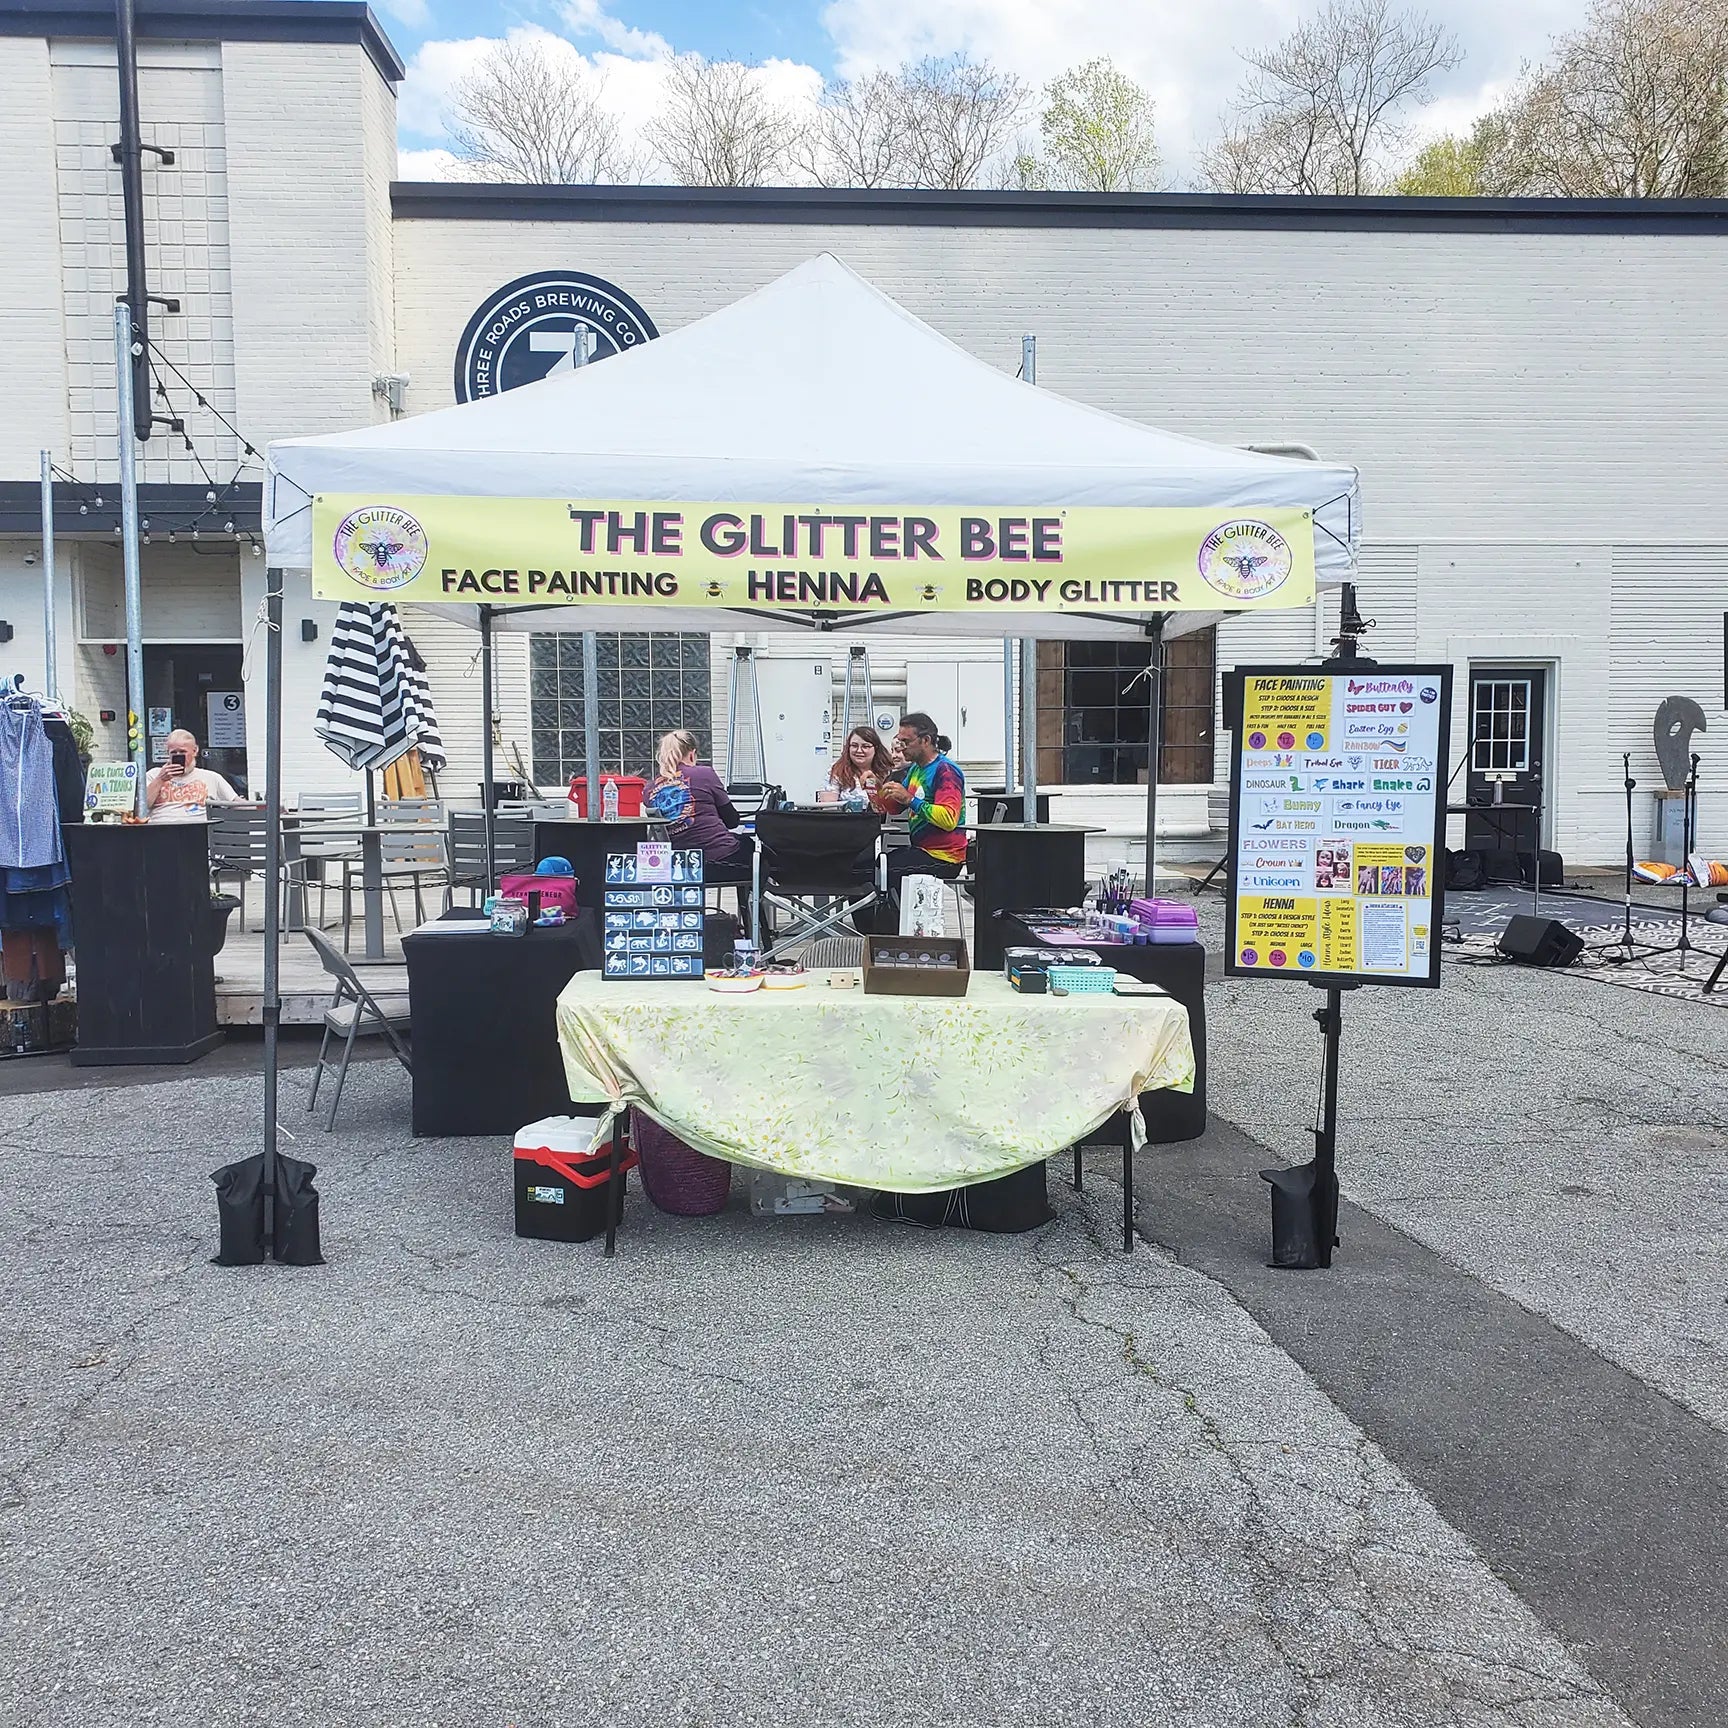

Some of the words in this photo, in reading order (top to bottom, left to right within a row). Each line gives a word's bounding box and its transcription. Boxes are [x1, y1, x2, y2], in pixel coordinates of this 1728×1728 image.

[477, 349, 492, 400] HREE
[485, 301, 531, 345] ROADS
[535, 293, 616, 323] BREWING
[340, 520, 359, 537] THE
[358, 511, 403, 525] GLITTER
[401, 520, 420, 537] BEE
[570, 510, 684, 556] THE
[700, 513, 945, 560] GLITTER
[960, 517, 1063, 562] BEE
[1205, 534, 1224, 551] THE
[1223, 525, 1267, 539] GLITTER
[1266, 534, 1284, 551] BEE
[353, 566, 371, 582] FACE
[380, 576, 400, 584] BODY
[401, 565, 412, 579] ART
[441, 569, 519, 593] FACE
[528, 570, 679, 596] PAINTING
[748, 570, 891, 604] HENNA
[1216, 579, 1235, 592] FACE
[1244, 585, 1264, 594] BODY
[1266, 573, 1276, 589] ART
[966, 578, 1052, 602] BODY
[1059, 580, 1182, 603] GLITTER
[1254, 679, 1278, 691] FACE
[1280, 679, 1325, 691] PAINTING
[1365, 680, 1413, 693] Butterfly
[227, 697, 237, 709] 3
[1346, 704, 1376, 713] SPIDER
[1378, 704, 1396, 712] GUY
[1348, 724, 1375, 734] Easter
[1378, 724, 1394, 735] Egg
[1345, 742, 1381, 750] RAINBOW
[1304, 759, 1328, 768] Tribal
[1329, 759, 1342, 767] Eye
[1373, 759, 1400, 769] TIGER
[1246, 780, 1286, 788] DINOSAUR
[1332, 780, 1365, 790] Shark
[1373, 779, 1413, 790] Snake
[1283, 799, 1321, 812] Bunny
[1356, 800, 1382, 811] Fancy
[1385, 799, 1402, 811] Eye
[1276, 821, 1292, 829] BAT
[1294, 821, 1315, 830] HERO
[1334, 820, 1370, 830] Dragon
[1243, 839, 1307, 850] FLOWERS
[1256, 857, 1286, 868] Crown
[1263, 898, 1295, 910] HENNA
